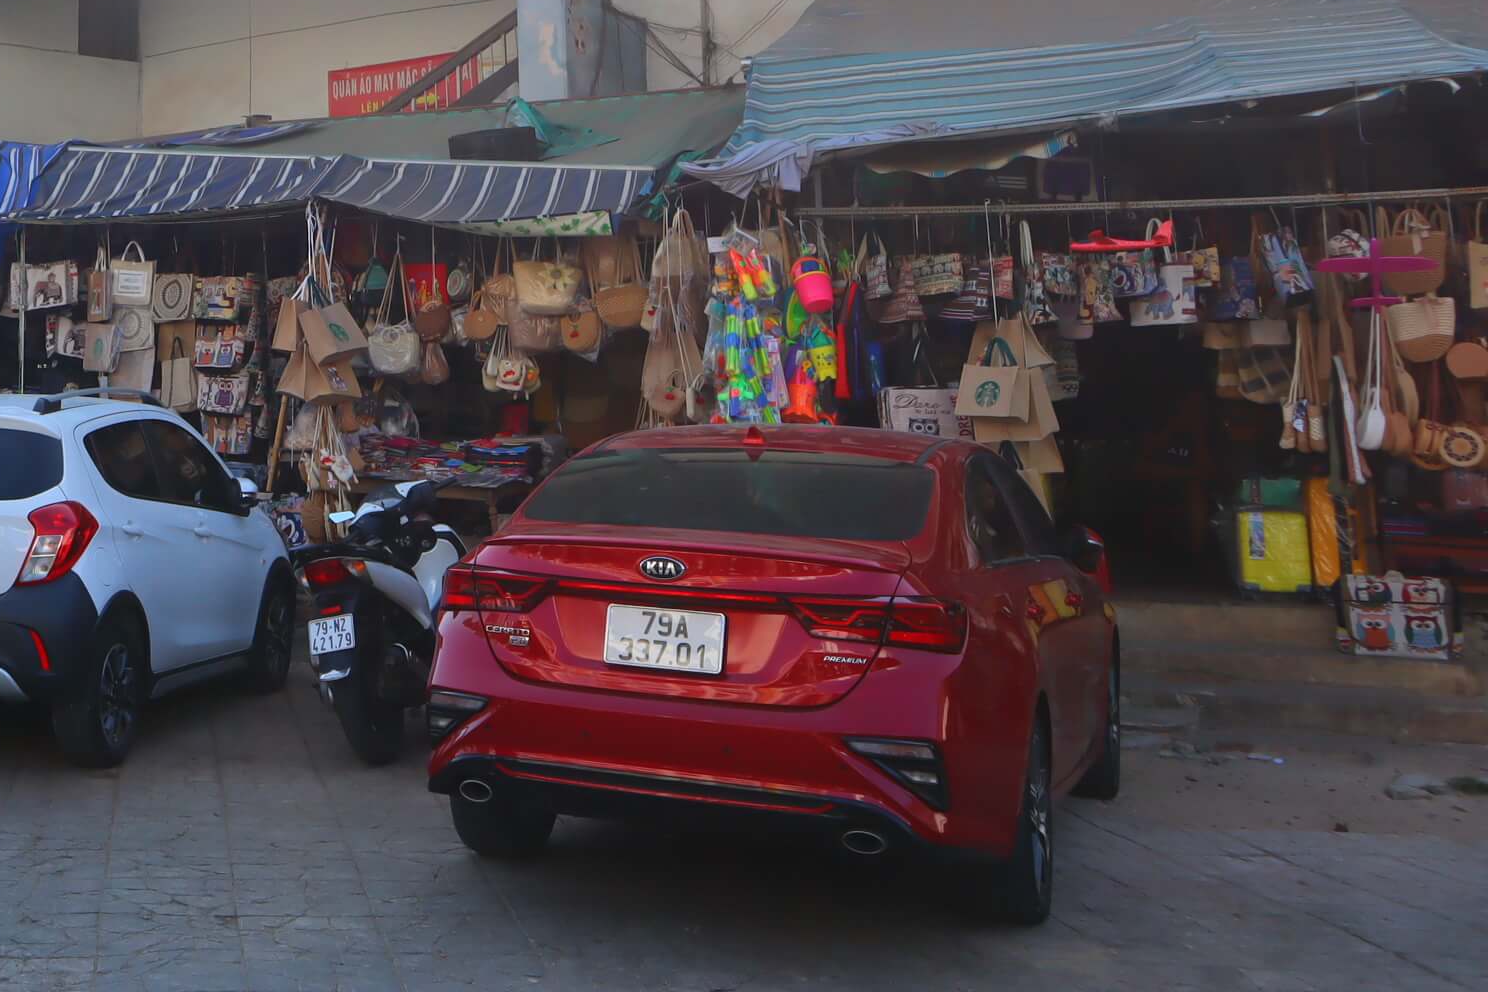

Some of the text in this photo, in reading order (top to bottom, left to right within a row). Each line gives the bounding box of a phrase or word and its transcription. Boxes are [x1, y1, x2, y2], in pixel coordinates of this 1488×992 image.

[374, 74, 394, 93] MAY
[646, 560, 677, 576] KIA
[642, 611, 689, 639] 79A
[313, 632, 352, 653] 421.79
[618, 637, 706, 669] 337.01
